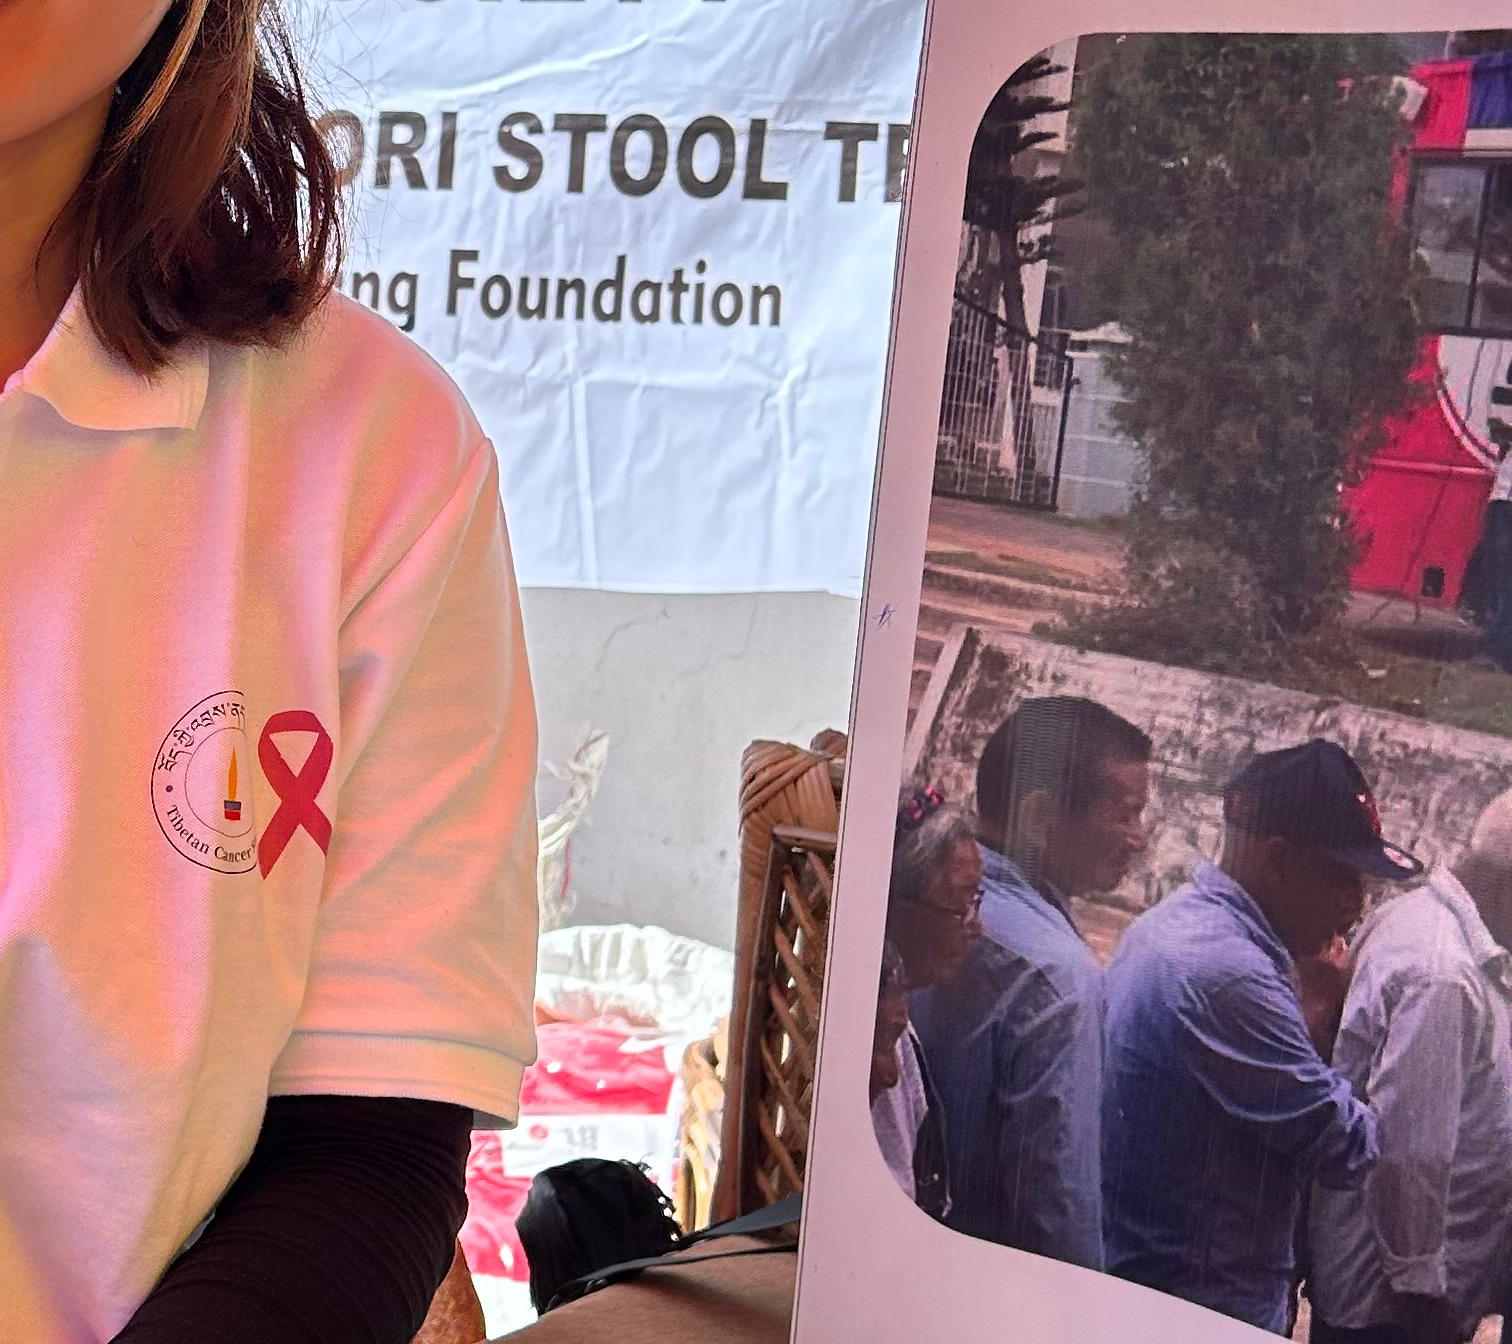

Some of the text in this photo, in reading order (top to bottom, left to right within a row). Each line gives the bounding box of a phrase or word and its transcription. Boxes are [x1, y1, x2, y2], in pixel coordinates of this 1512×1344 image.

[314, 109, 456, 191] ORI
[492, 111, 788, 201] STOOL
[339, 270, 419, 333] ng
[445, 248, 782, 330] Foundation
[166, 804, 253, 863] Tibetan Cancer
